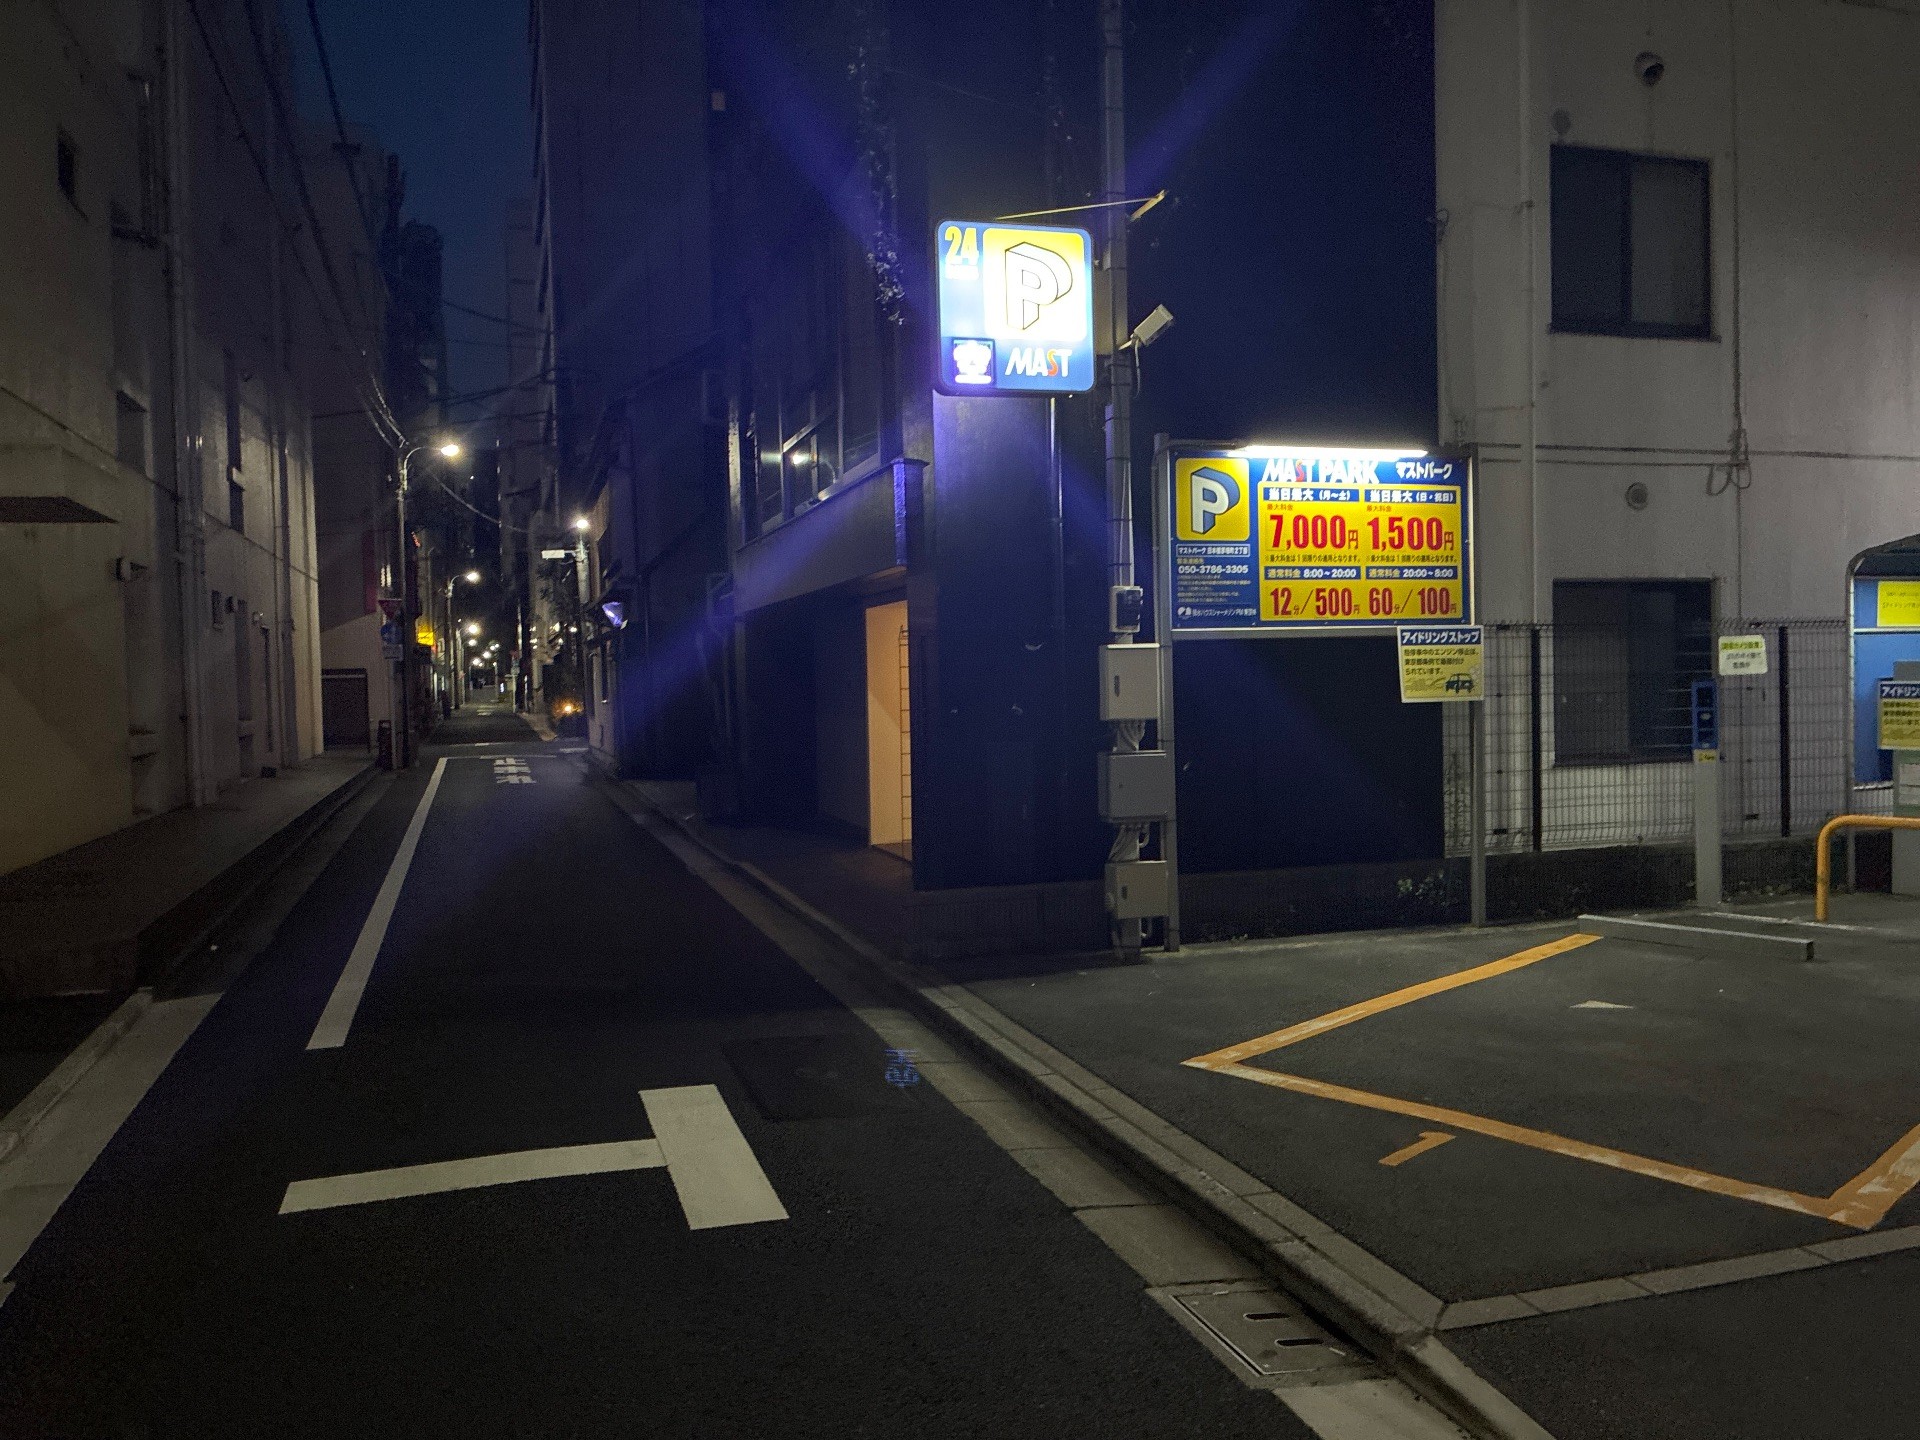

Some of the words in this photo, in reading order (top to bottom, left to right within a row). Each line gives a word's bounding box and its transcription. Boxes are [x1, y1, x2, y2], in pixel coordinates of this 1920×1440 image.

[945, 226, 979, 265] 24
[1005, 241, 1073, 330] P
[1005, 347, 1073, 377] MAST
[1262, 459, 1316, 482] MAST
[1318, 459, 1379, 484] PARK
[1395, 461, 1453, 479] マストパーク
[1191, 466, 1241, 535] P
[1268, 488, 1314, 501] 当日最大
[1370, 490, 1413, 503] 当日最大
[1178, 547, 1206, 555] マストパーク
[1178, 565, 1249, 574] 050-3786-3305
[1267, 569, 1301, 578] 通常料金
[1369, 569, 1401, 578] 通常料金
[1402, 631, 1480, 644] アイドリングストップ
